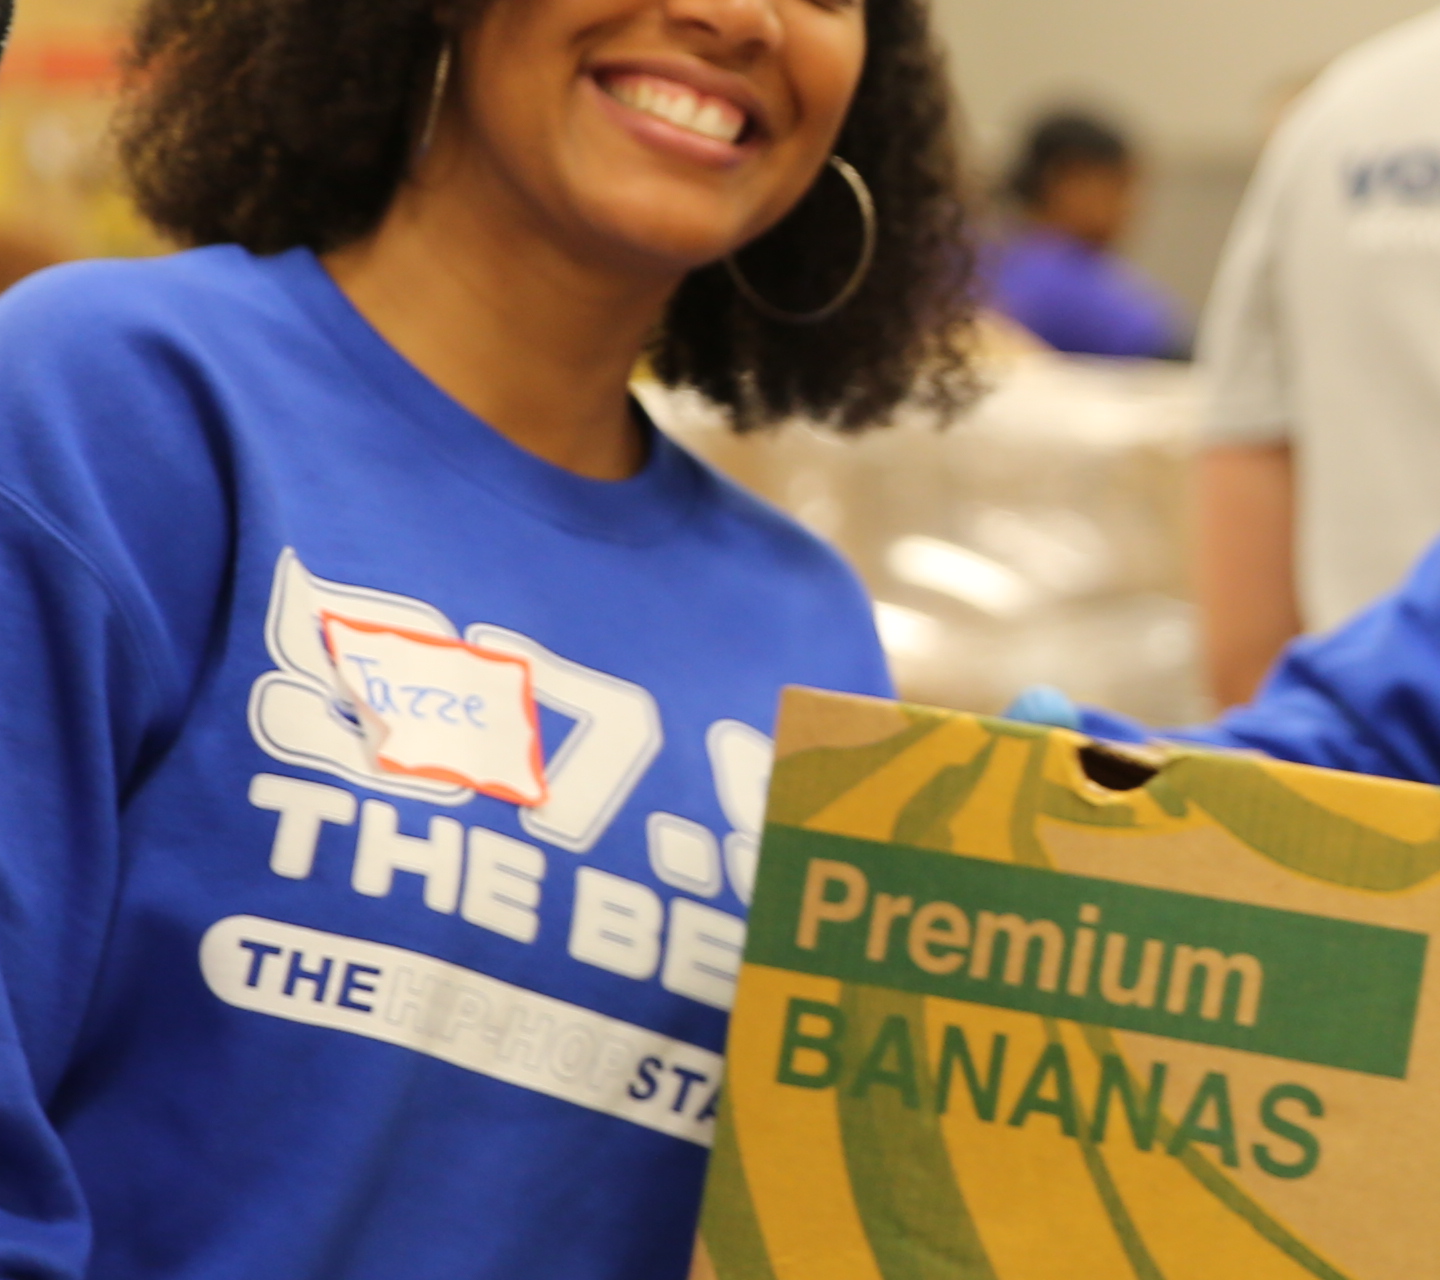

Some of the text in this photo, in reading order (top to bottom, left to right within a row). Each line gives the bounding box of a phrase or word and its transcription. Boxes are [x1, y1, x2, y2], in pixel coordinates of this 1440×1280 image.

[249, 773, 546, 944] THE
[796, 858, 1265, 1027] Premium
[238, 939, 382, 1014] THE
[776, 997, 1325, 1178] BANANAS
